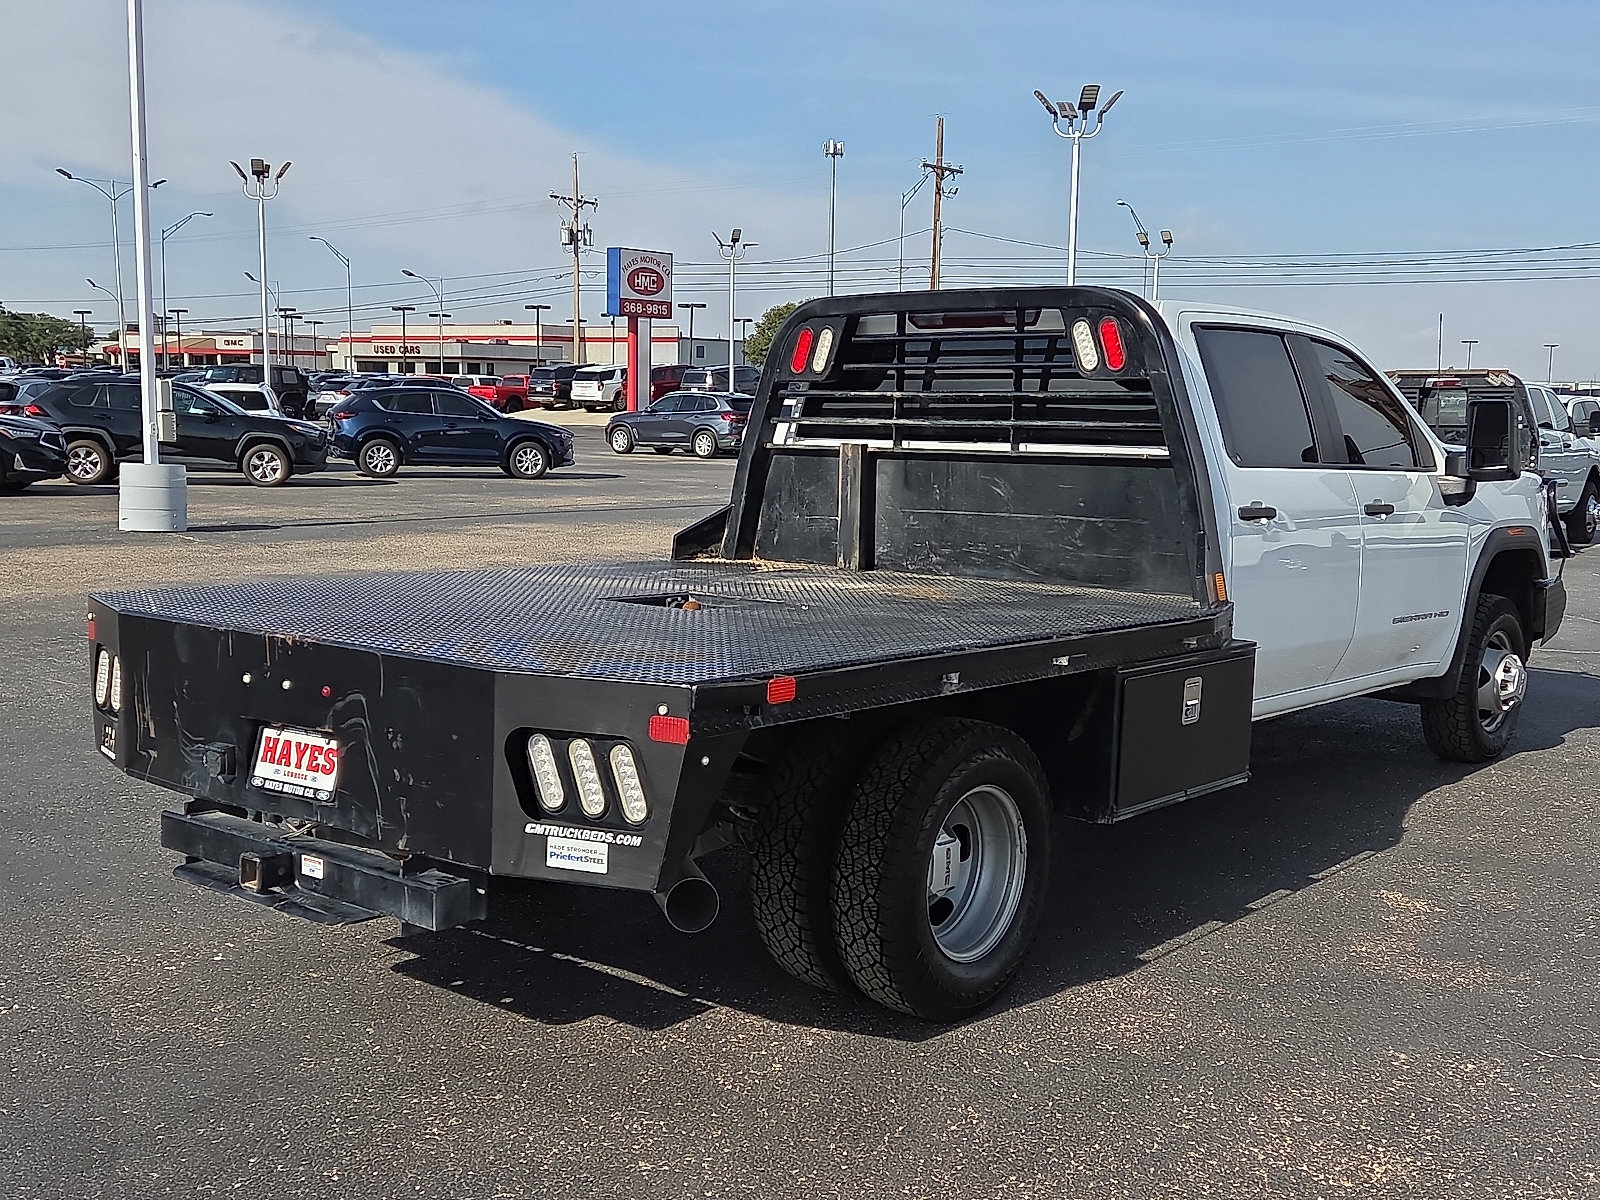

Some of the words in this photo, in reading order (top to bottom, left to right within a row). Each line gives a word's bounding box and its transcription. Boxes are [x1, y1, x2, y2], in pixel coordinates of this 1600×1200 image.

[621, 257, 639, 274] HAYES
[640, 256, 661, 268] MOTOR
[661, 264, 671, 278] CO.
[634, 272, 658, 291] HMC
[623, 302, 668, 315] 368-9815
[373, 345, 396, 354] USED
[398, 345, 421, 354] CARS
[260, 736, 339, 775] HAYES
[264, 780, 283, 791] HAYES
[282, 783, 304, 795] MOTOR
[524, 822, 643, 847] CMTRUCKBEDS.COM
[944, 847, 952, 886] GMC
